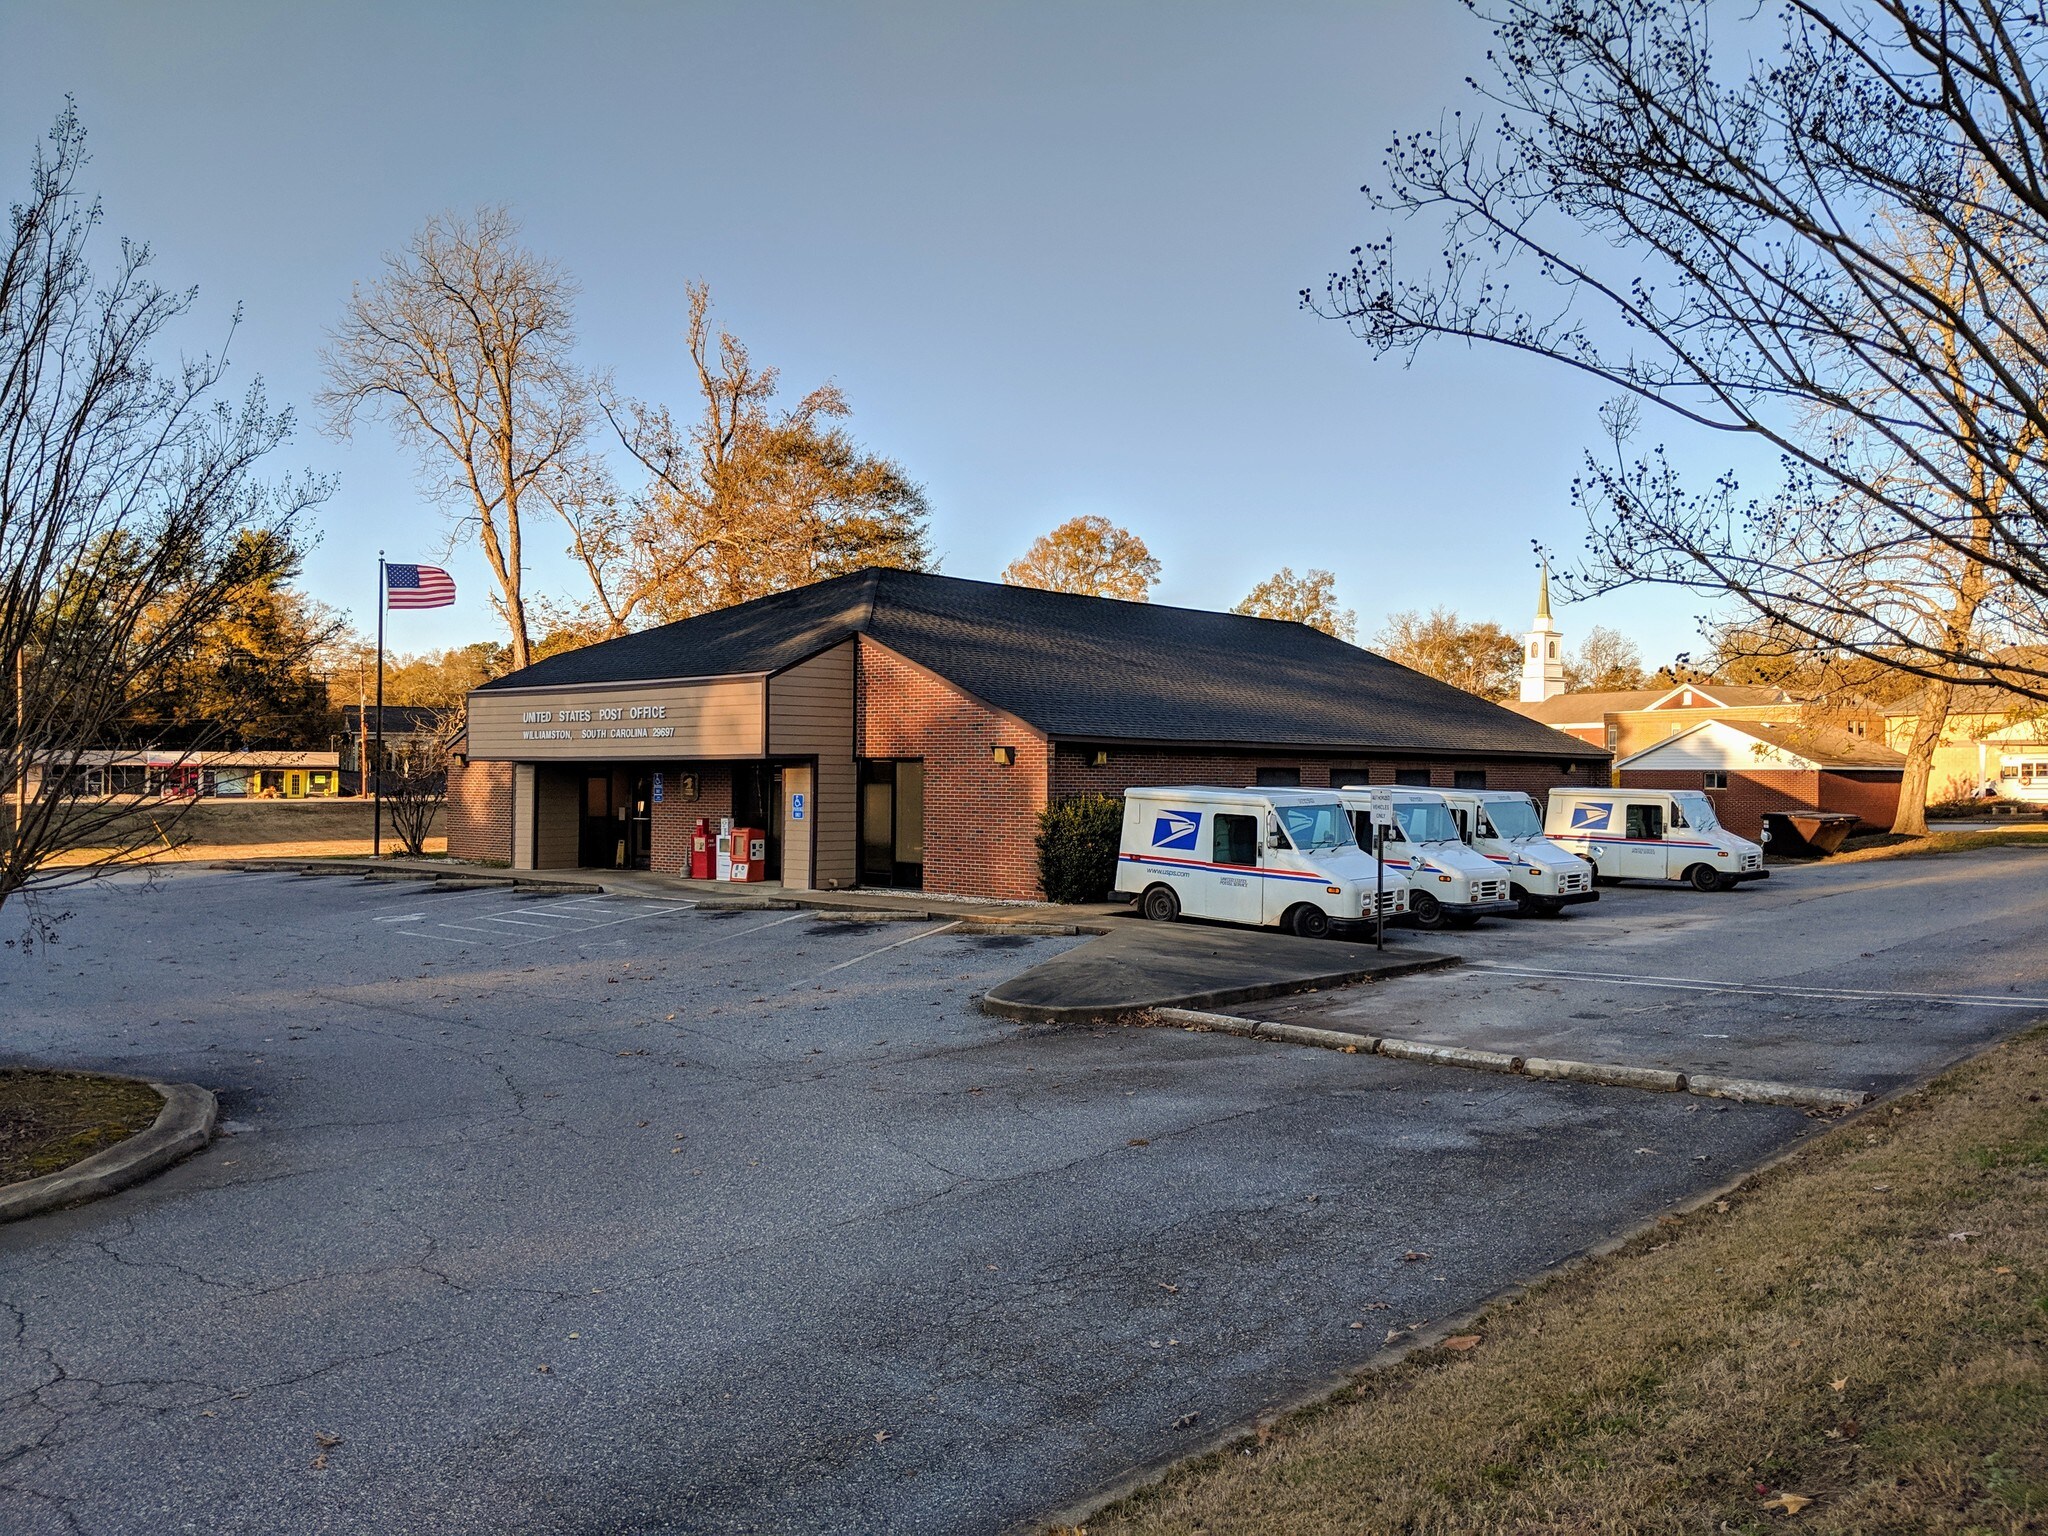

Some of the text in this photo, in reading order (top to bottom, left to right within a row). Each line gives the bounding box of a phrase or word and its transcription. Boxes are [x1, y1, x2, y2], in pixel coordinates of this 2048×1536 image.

[523, 706, 666, 723] UNITED STATES POST OFFICE
[523, 727, 675, 741] WILLIAMSTON, SOUTH CAROLINA 29697
[1146, 867, 1190, 878] www.usps.com
